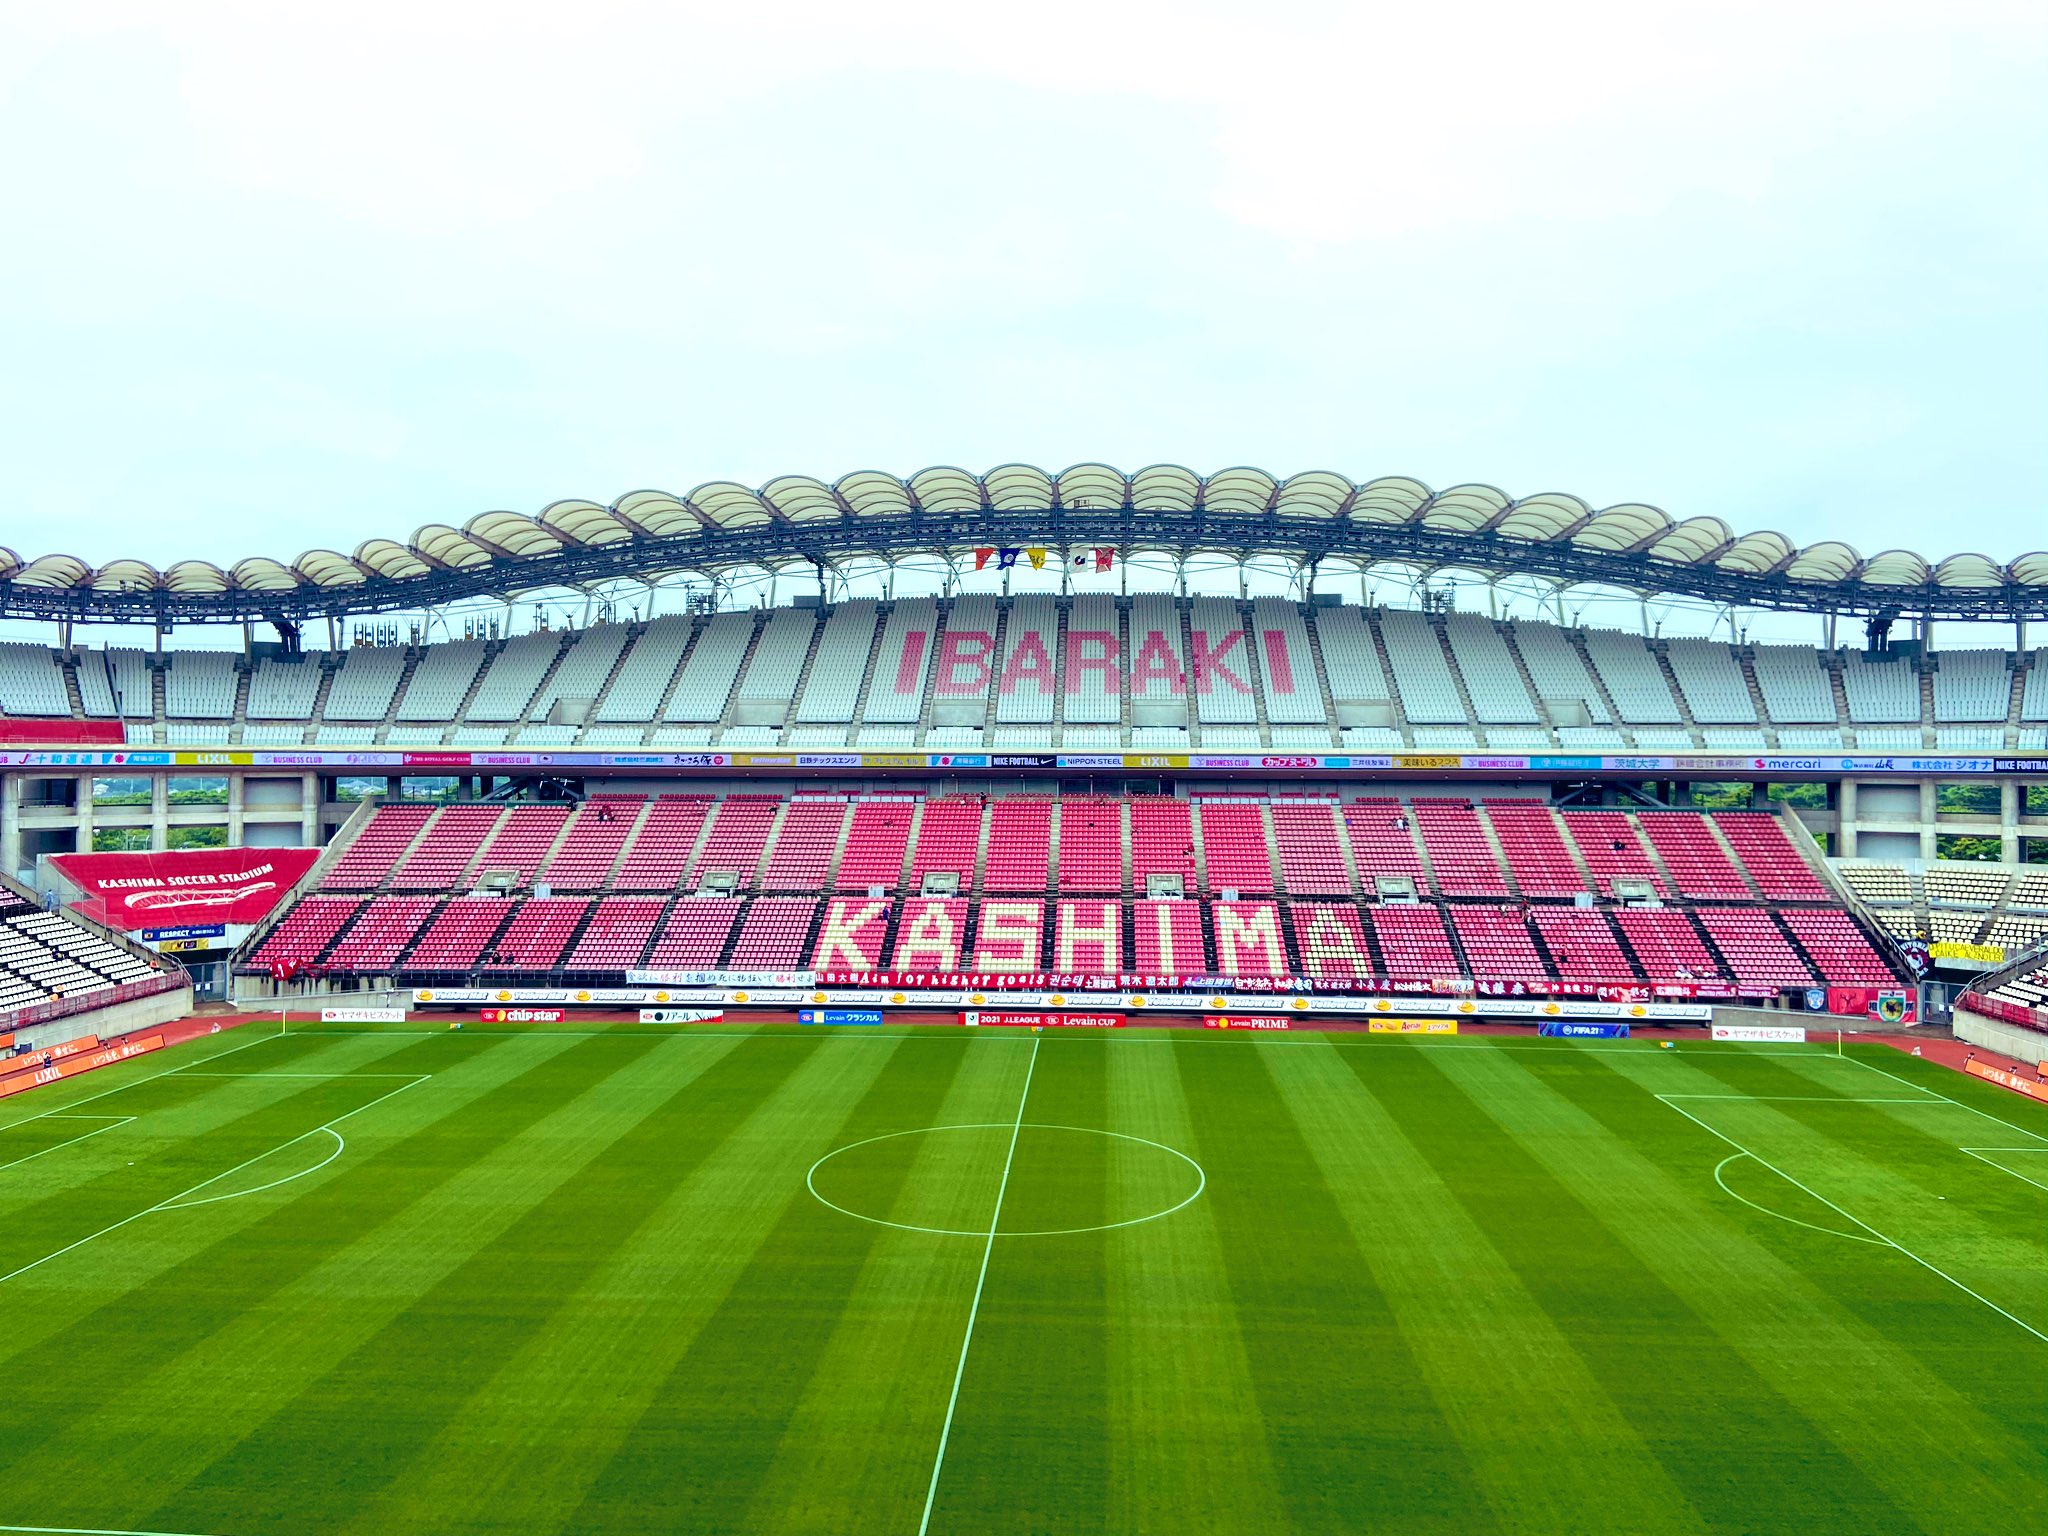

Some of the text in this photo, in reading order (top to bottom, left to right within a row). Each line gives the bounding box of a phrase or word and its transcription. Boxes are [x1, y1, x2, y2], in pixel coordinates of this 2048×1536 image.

[894, 629, 1295, 695] IBARAKI
[197, 754, 232, 764] LIXIL
[273, 756, 322, 764] BUSINESS CLUB
[488, 756, 515, 764] BUSINESS
[993, 757, 1039, 766] NIKE FOOTBALL
[1140, 757, 1170, 766] LIXIL
[1206, 759, 1250, 767] BUSINESS CLUB
[1615, 758, 1660, 768] 茨城大学
[1478, 760, 1524, 768] BUSINESS CLUB
[1768, 759, 1821, 769] mercari
[1996, 760, 2048, 770] NIKE FOOTBA
[97, 863, 274, 889] KASHIMA SOCCER STADIUM
[159, 930, 190, 938] RESPECT
[814, 901, 1369, 978] KASHIMA
[860, 972, 1045, 987] Aim for higher goals
[1583, 984, 1594, 993] 31
[339, 1011, 402, 1019] ヤマザキビスケット
[695, 1012, 716, 1022] Noir
[1063, 1017, 1096, 1026] Levain
[1251, 1019, 1288, 1029] PRIME
[1732, 1029, 1802, 1038] ヤマザキビスケット
[34, 1067, 62, 1083] LIXIL
